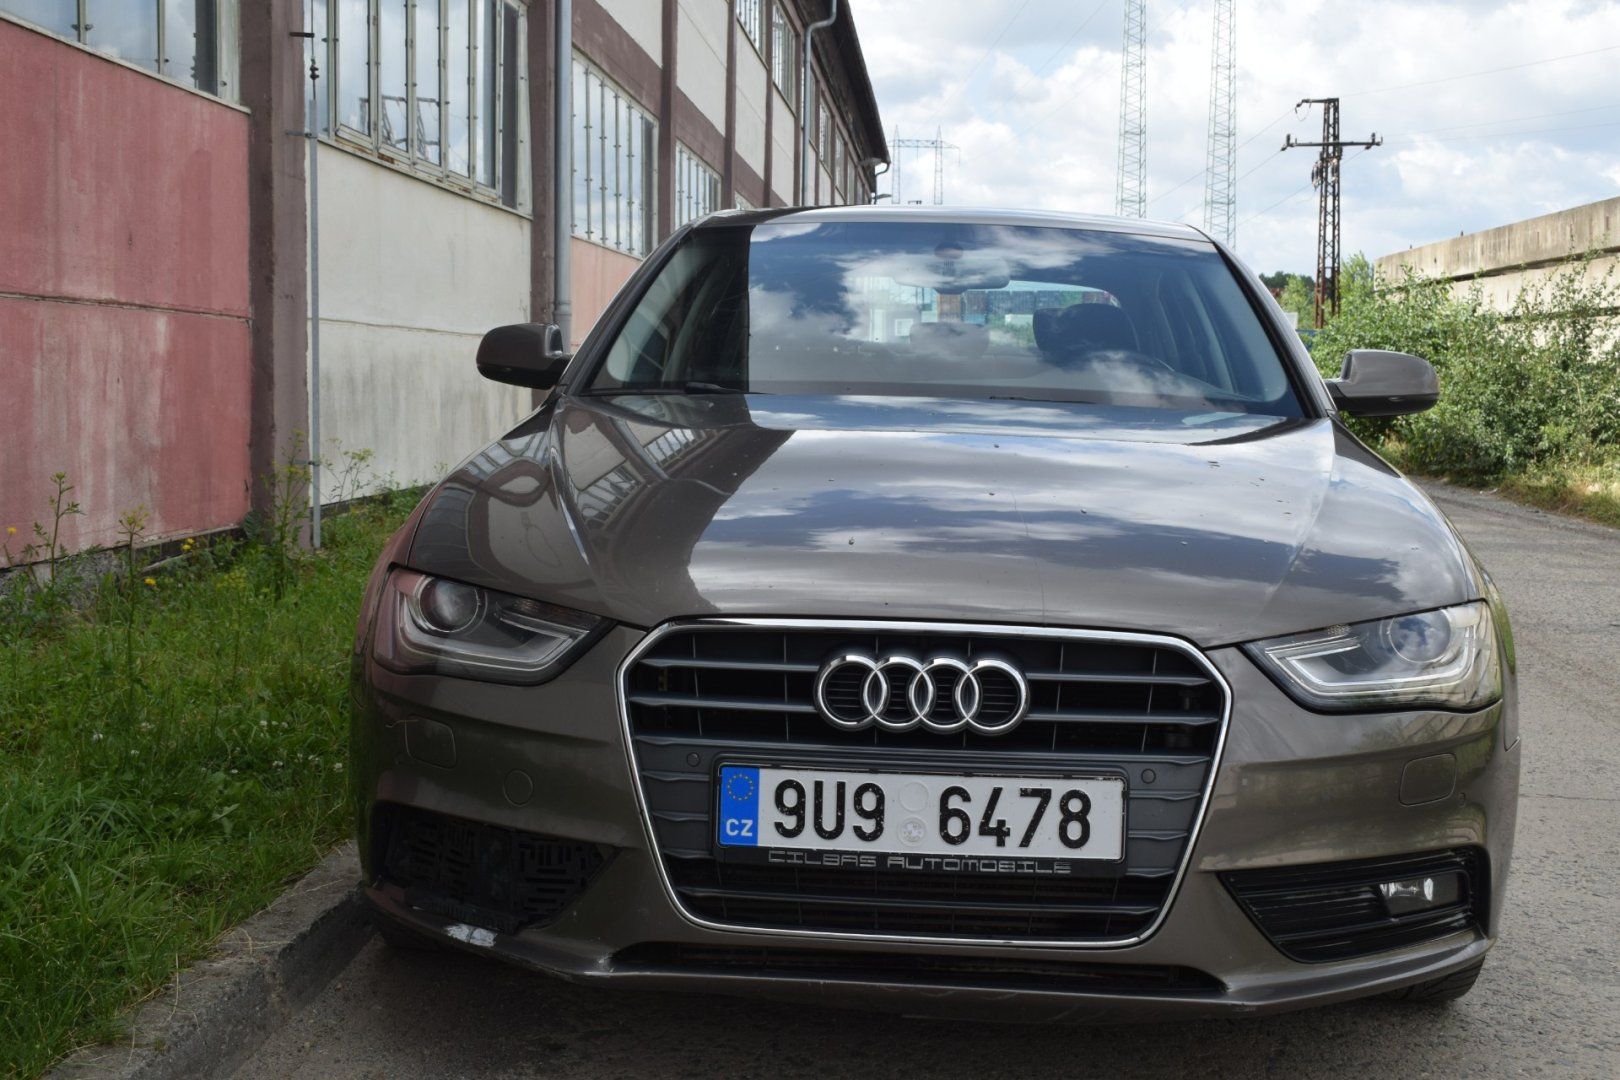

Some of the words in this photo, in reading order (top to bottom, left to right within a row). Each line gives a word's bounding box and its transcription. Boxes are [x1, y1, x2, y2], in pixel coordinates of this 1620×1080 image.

[773, 779, 886, 842] 9U9
[939, 785, 1092, 849] 6478
[725, 819, 753, 837] CZ
[887, 856, 1072, 874] AUTOMOBILE
